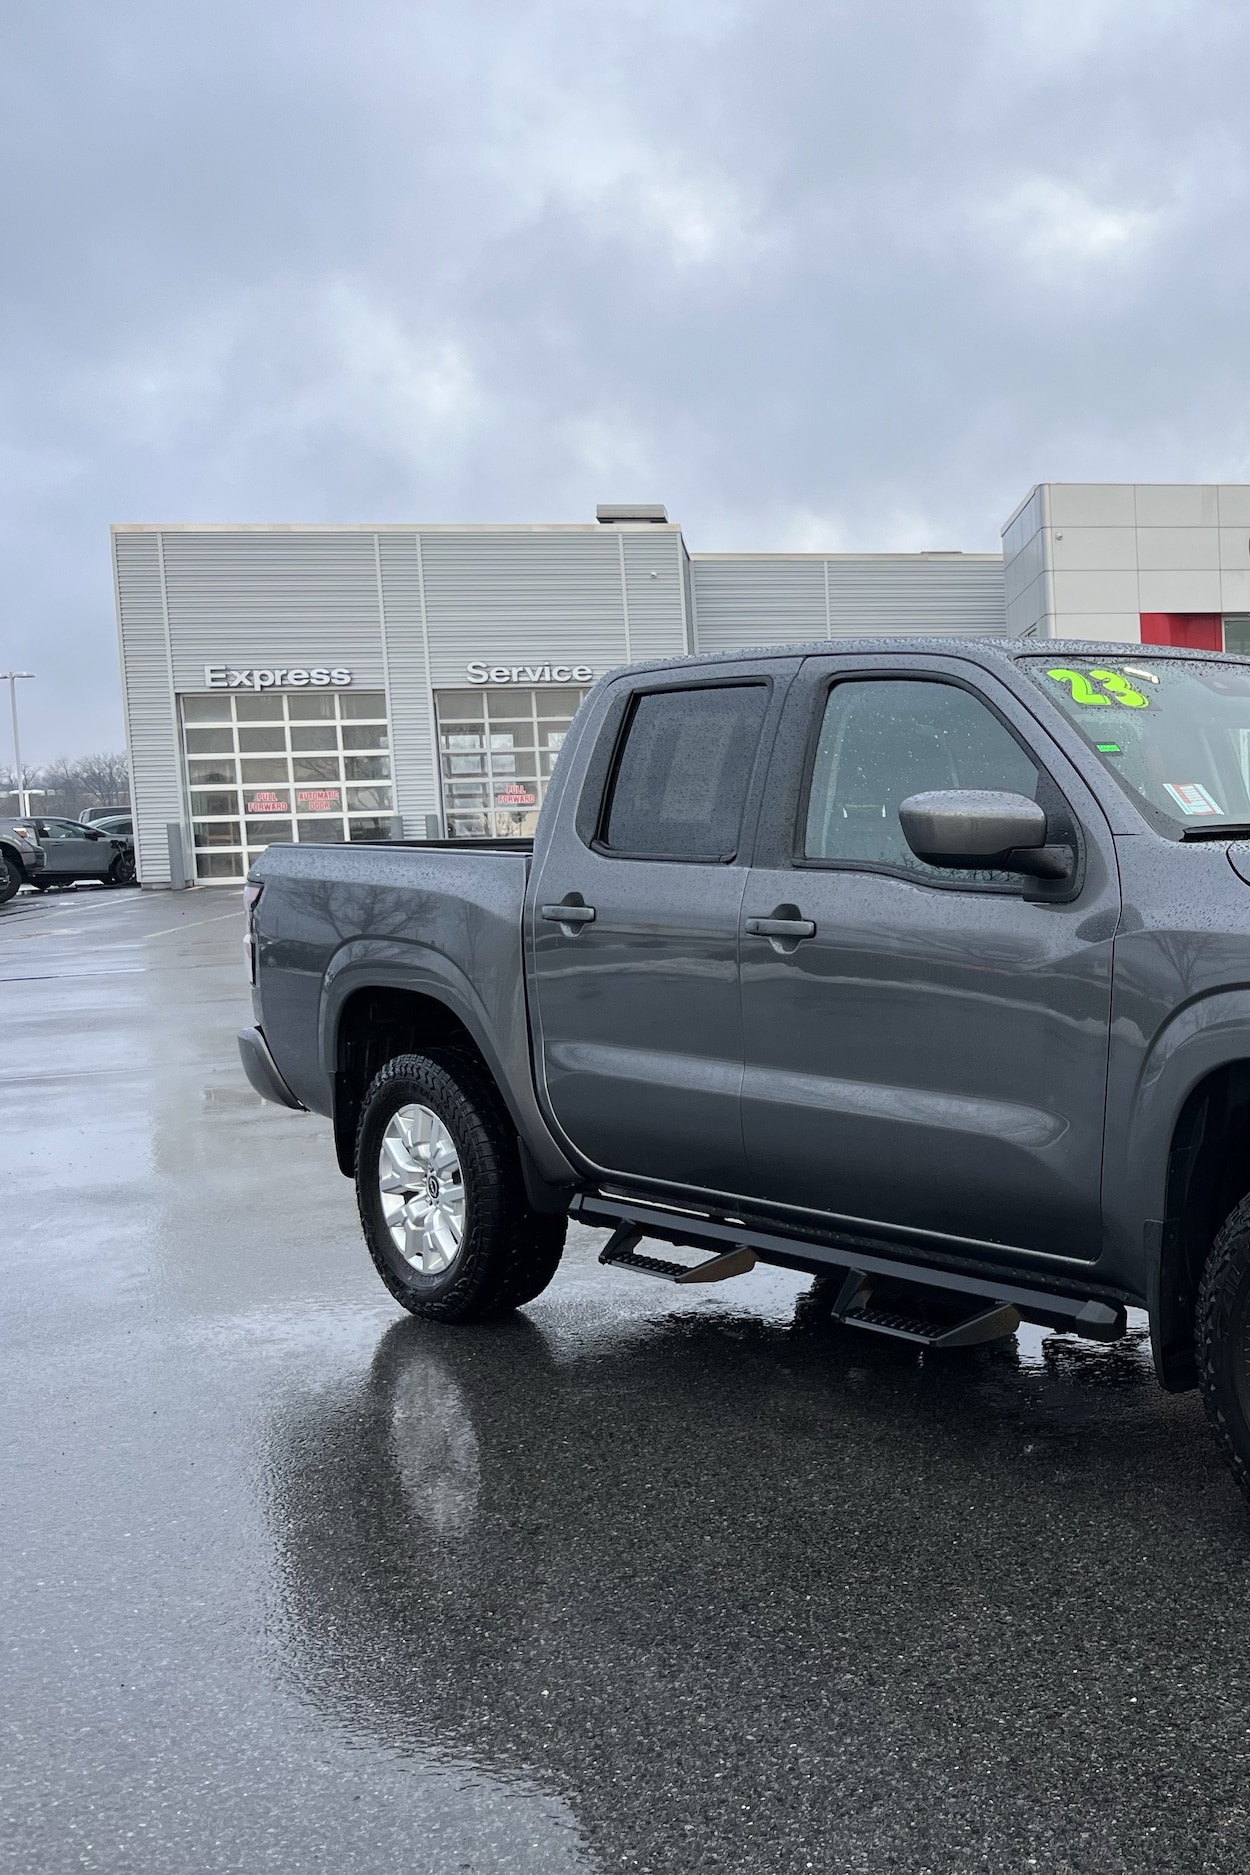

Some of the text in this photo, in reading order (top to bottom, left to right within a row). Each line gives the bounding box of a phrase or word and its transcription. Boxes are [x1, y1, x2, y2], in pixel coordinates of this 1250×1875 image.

[204, 664, 351, 691] Express
[466, 661, 593, 684] Service
[1047, 669, 1149, 708] 23
[506, 785, 526, 794] PULL
[256, 792, 278, 801] PULL
[299, 791, 339, 801] AUTOMATIC
[498, 794, 535, 804] FORWARD
[248, 802, 288, 812] FORWARD
[309, 801, 330, 810] DOOR
